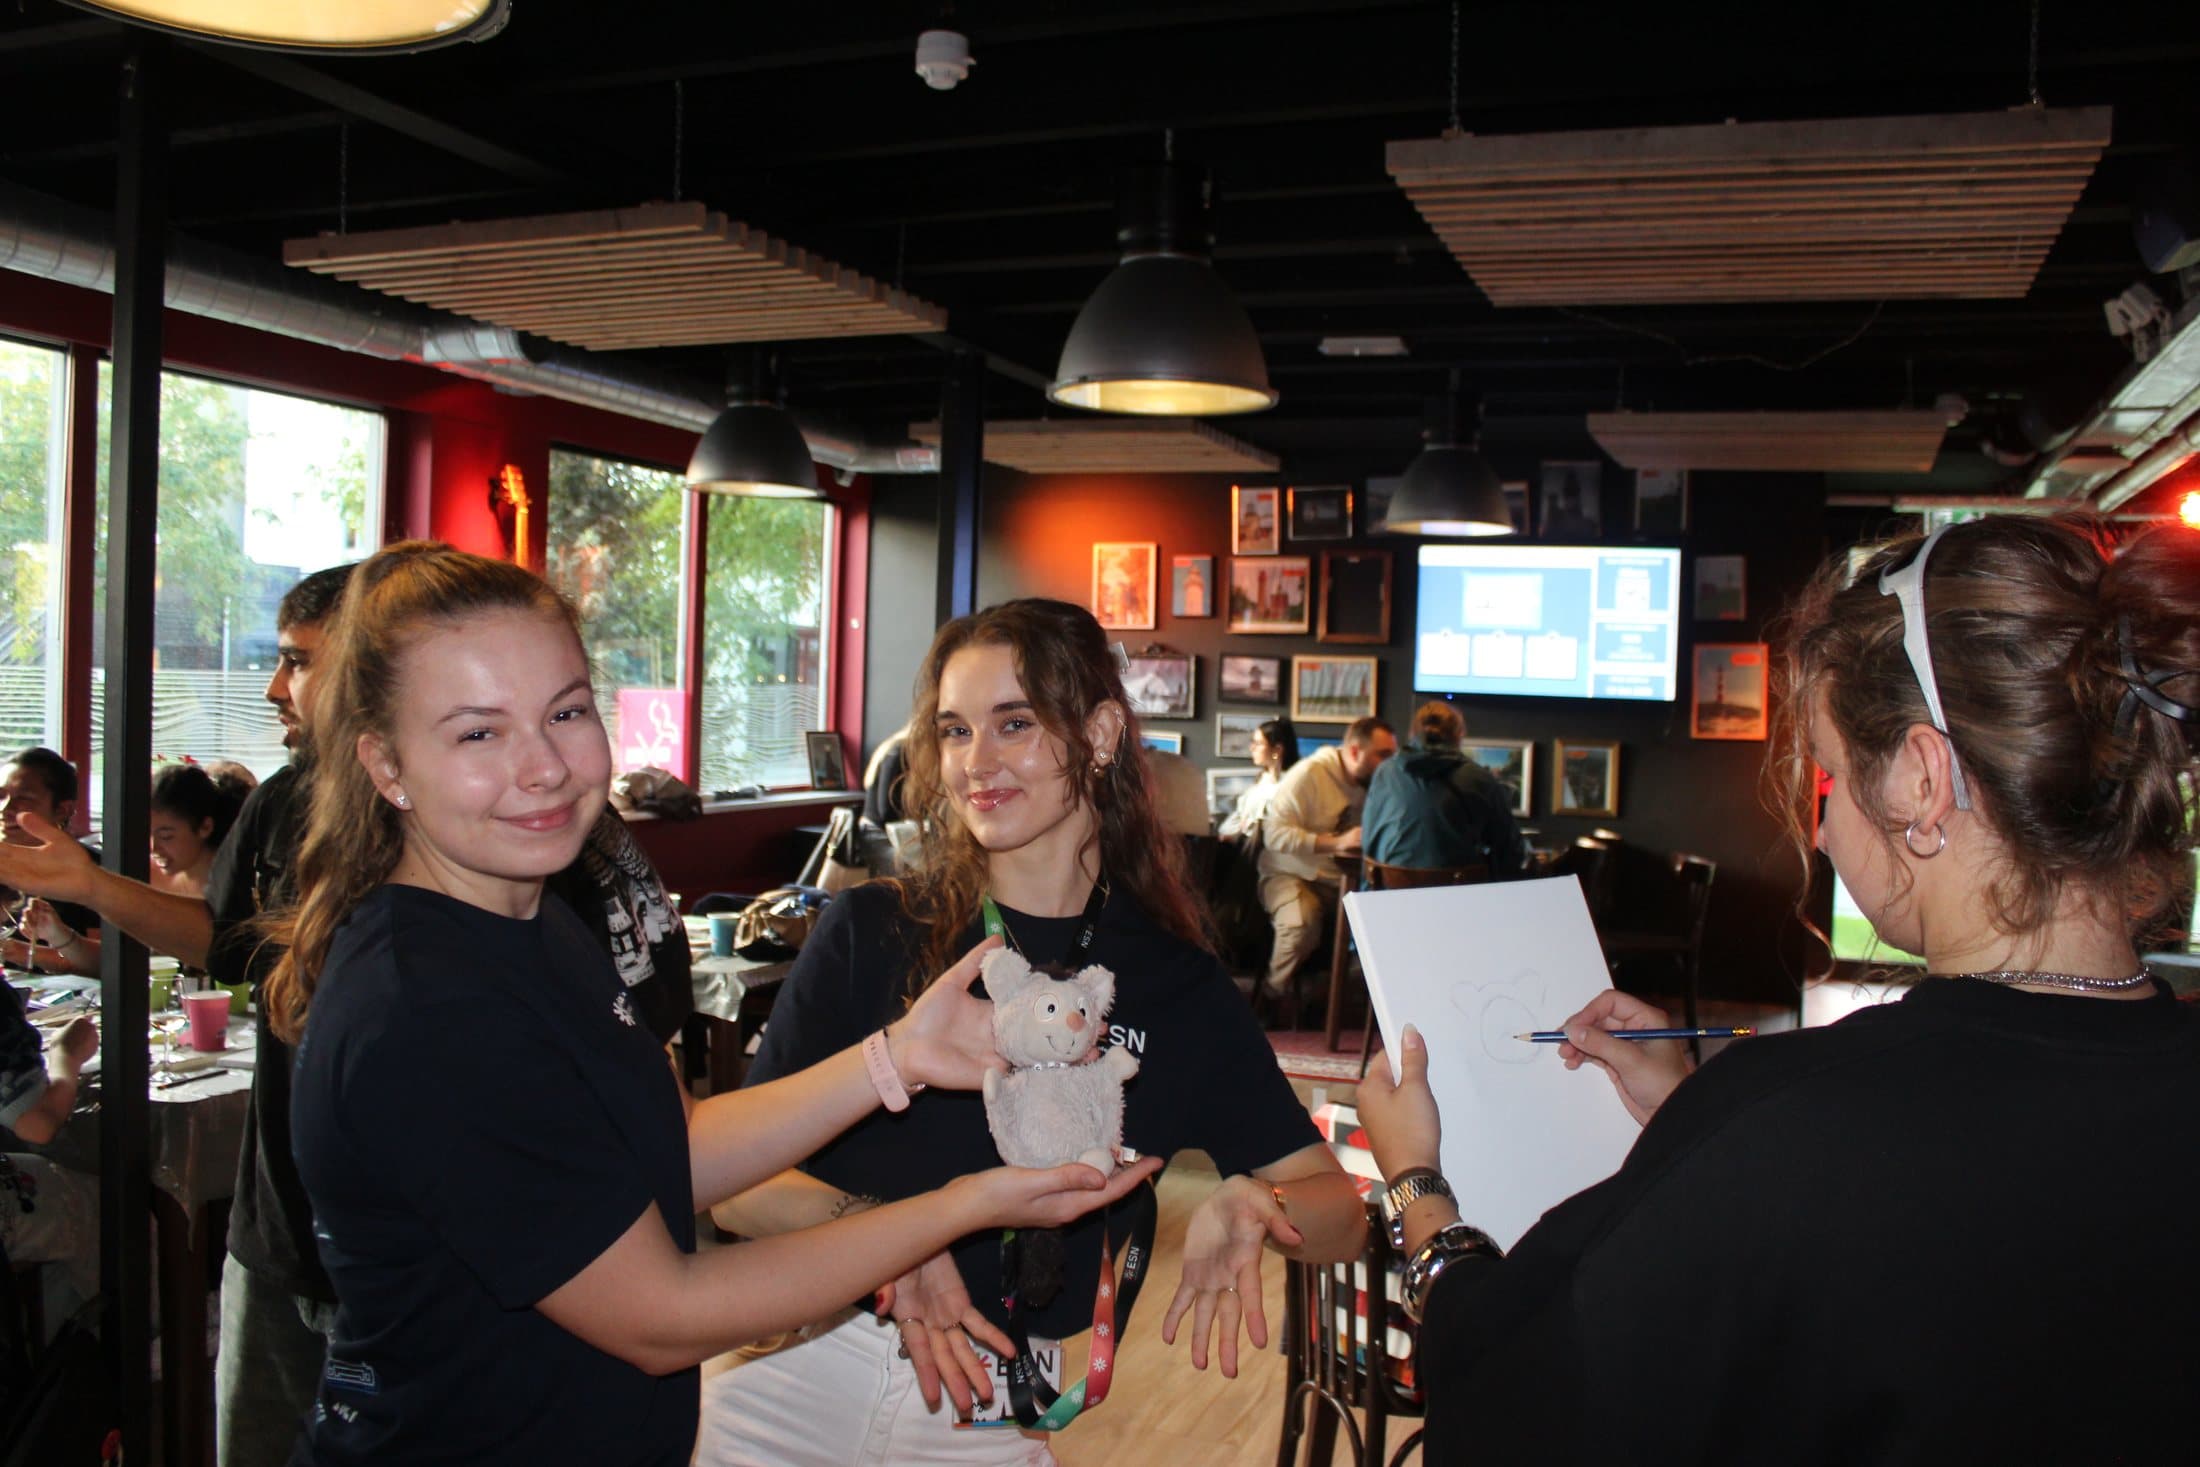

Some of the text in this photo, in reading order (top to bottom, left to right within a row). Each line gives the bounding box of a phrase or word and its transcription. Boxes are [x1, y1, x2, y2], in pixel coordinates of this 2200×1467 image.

[1108, 1024, 1146, 1054] SN
[1126, 1246, 1140, 1270] ESN
[997, 1350, 1053, 1377] EN
[1015, 1362, 1025, 1384] ESN
